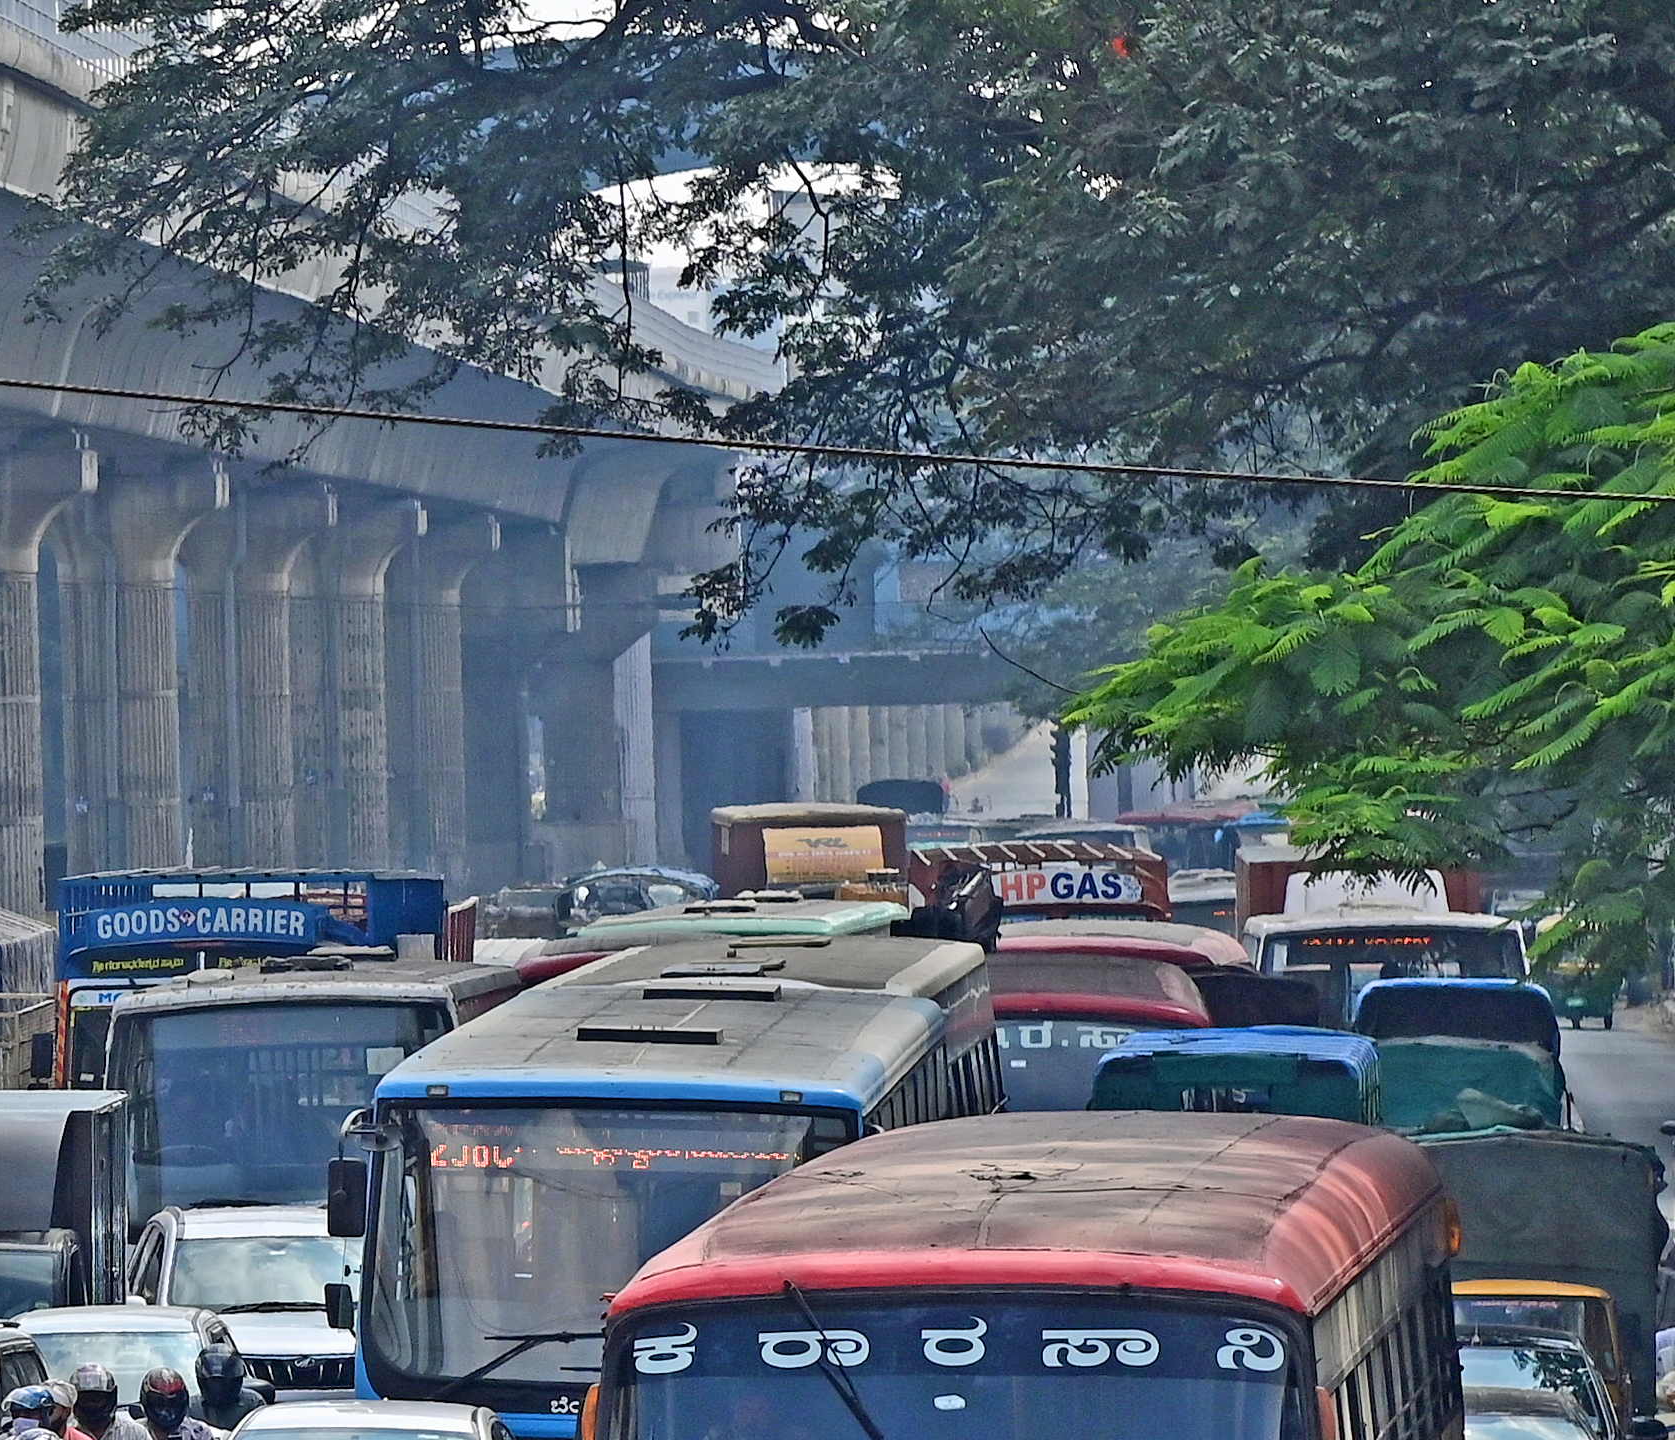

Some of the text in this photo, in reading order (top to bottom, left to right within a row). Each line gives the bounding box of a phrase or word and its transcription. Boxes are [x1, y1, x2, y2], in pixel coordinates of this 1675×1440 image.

[1000, 872, 1122, 900] HP GAS
[97, 907, 306, 939] GOODS CARRIER
[758, 1326, 870, 1368] ರಾ
[920, 1314, 988, 1367] ರ
[1041, 1326, 1160, 1367] ಸಾ
[1215, 1326, 1285, 1373] ನಿ
